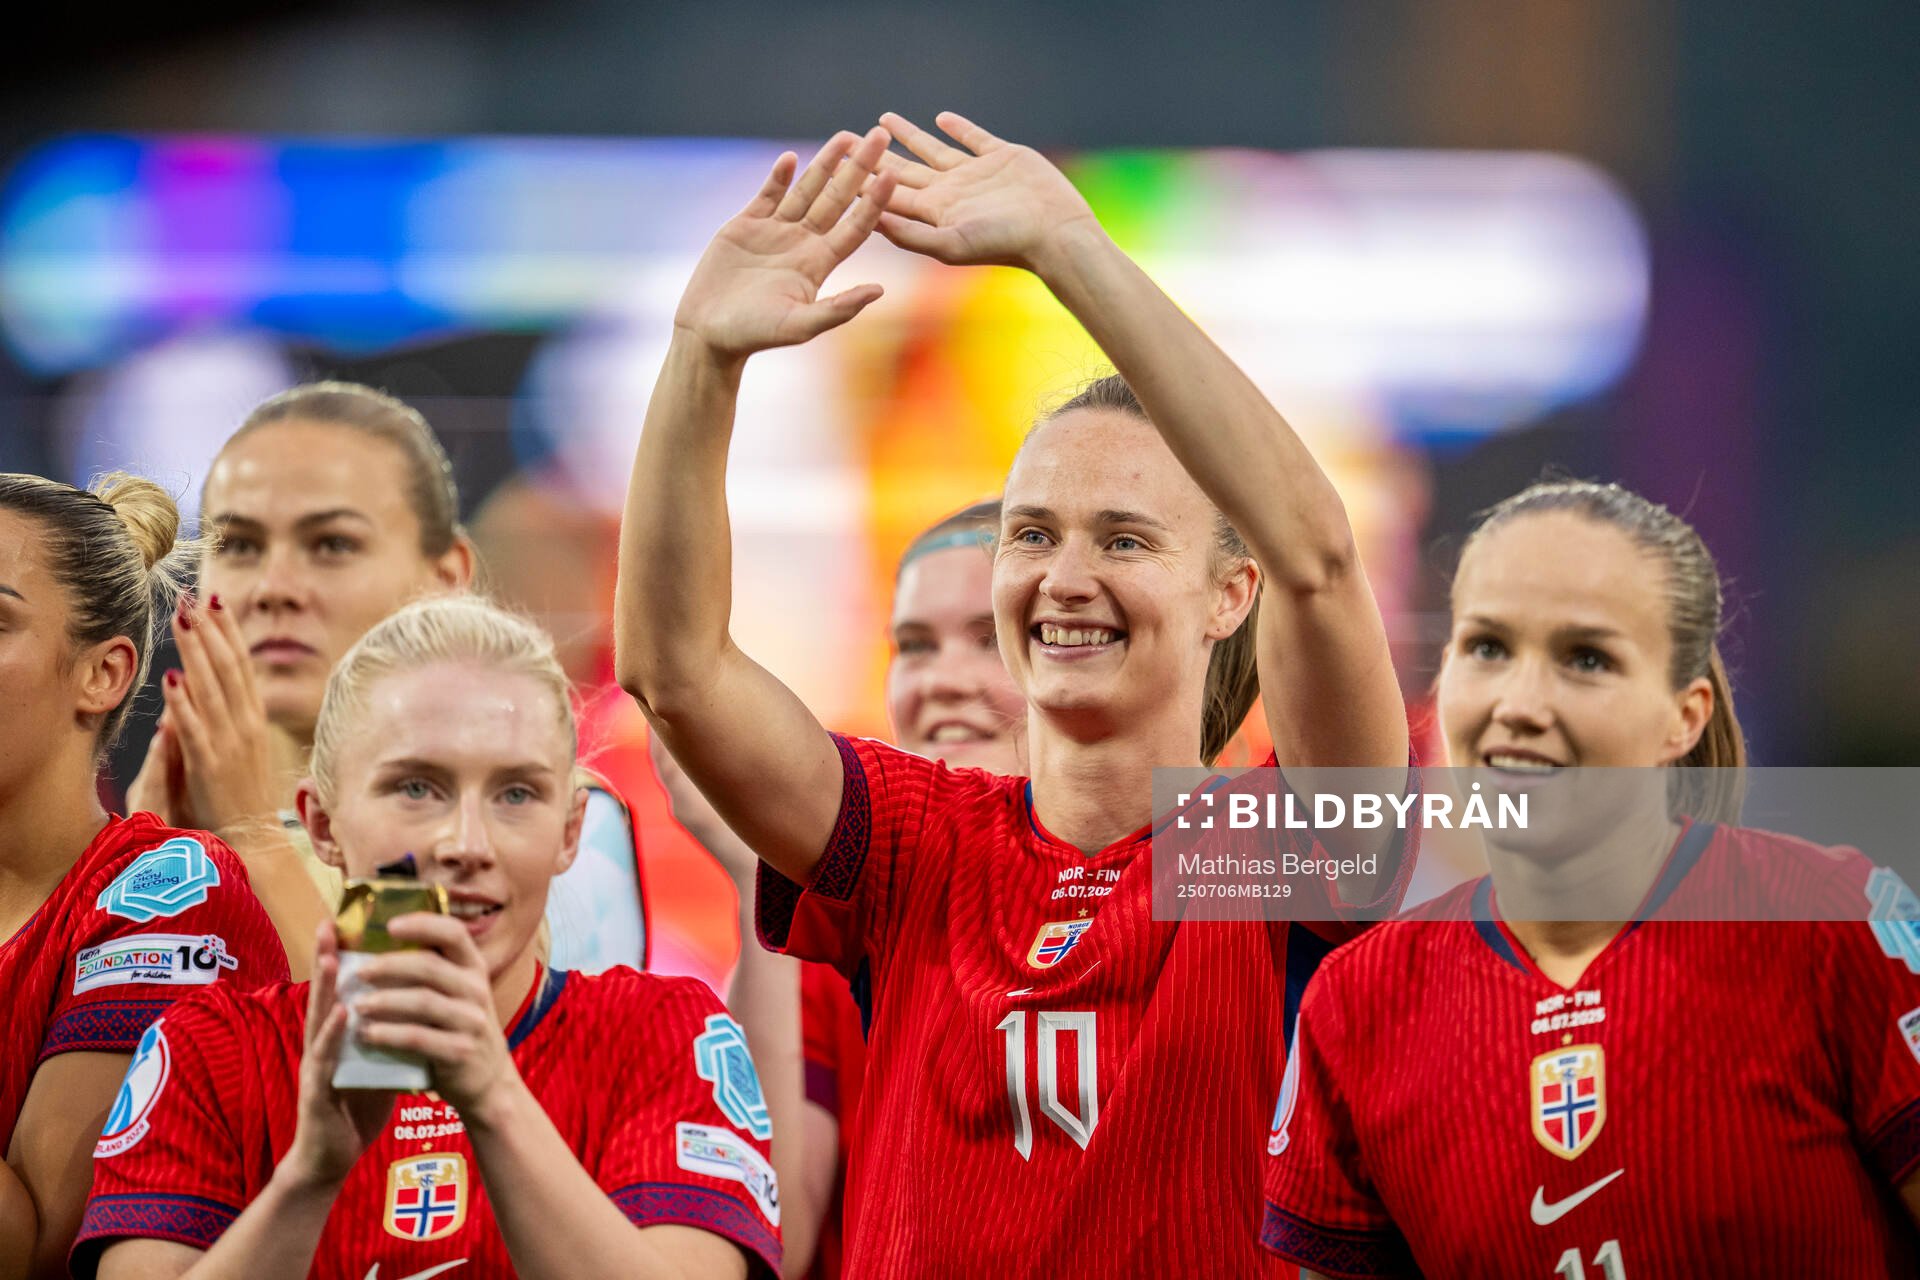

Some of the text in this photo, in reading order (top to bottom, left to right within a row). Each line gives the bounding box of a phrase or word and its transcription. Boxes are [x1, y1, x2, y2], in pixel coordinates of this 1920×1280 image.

[1058, 866, 1085, 884] NOR
[1096, 869, 1121, 882] FIN
[1051, 885, 1113, 900] 06.07.202
[177, 946, 217, 970] 10
[131, 970, 172, 981] for children
[995, 1010, 1099, 1163] 10
[400, 1106, 433, 1122] NOR
[1554, 1239, 1626, 1280] 11
